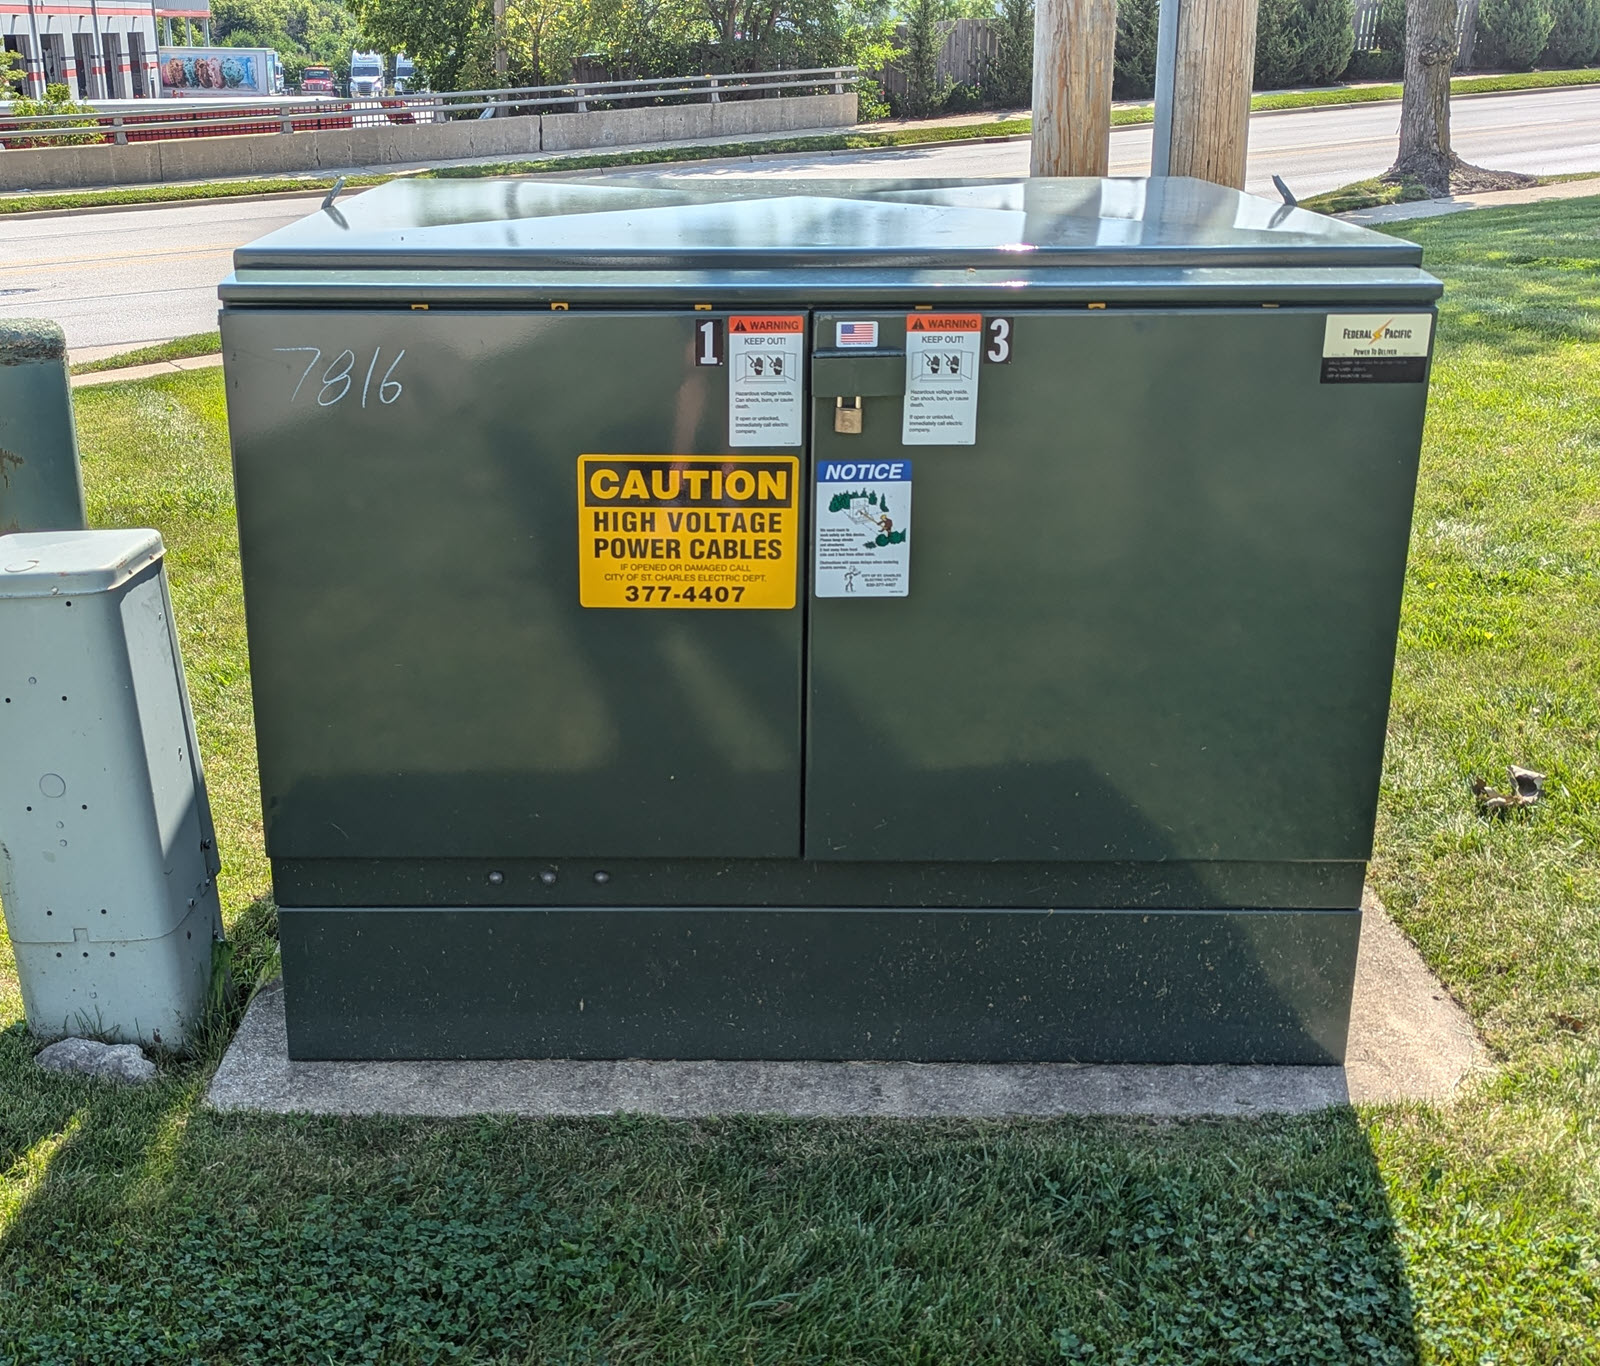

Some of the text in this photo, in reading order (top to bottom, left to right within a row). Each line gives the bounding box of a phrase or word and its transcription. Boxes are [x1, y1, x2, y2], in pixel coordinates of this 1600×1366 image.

[750, 321, 799, 330] WARNING
[927, 319, 977, 329] WARNING
[700, 321, 718, 365] 1
[744, 337, 786, 345] KEEP OUT!
[921, 336, 964, 344] KEEP OUT!
[988, 318, 1010, 363] 3
[272, 347, 405, 408] 7816
[825, 463, 904, 480] NOTICE
[590, 469, 787, 500] CAUTION
[593, 511, 782, 533] HIGH VOLTAGE
[593, 538, 783, 560] POWER CABLES
[620, 564, 751, 572] IF OPENED OR DAMAGED CALL
[604, 574, 767, 582] CITY OF ST. CHARLES ELECTRIC DEPT.
[625, 586, 746, 602] 377-4407
